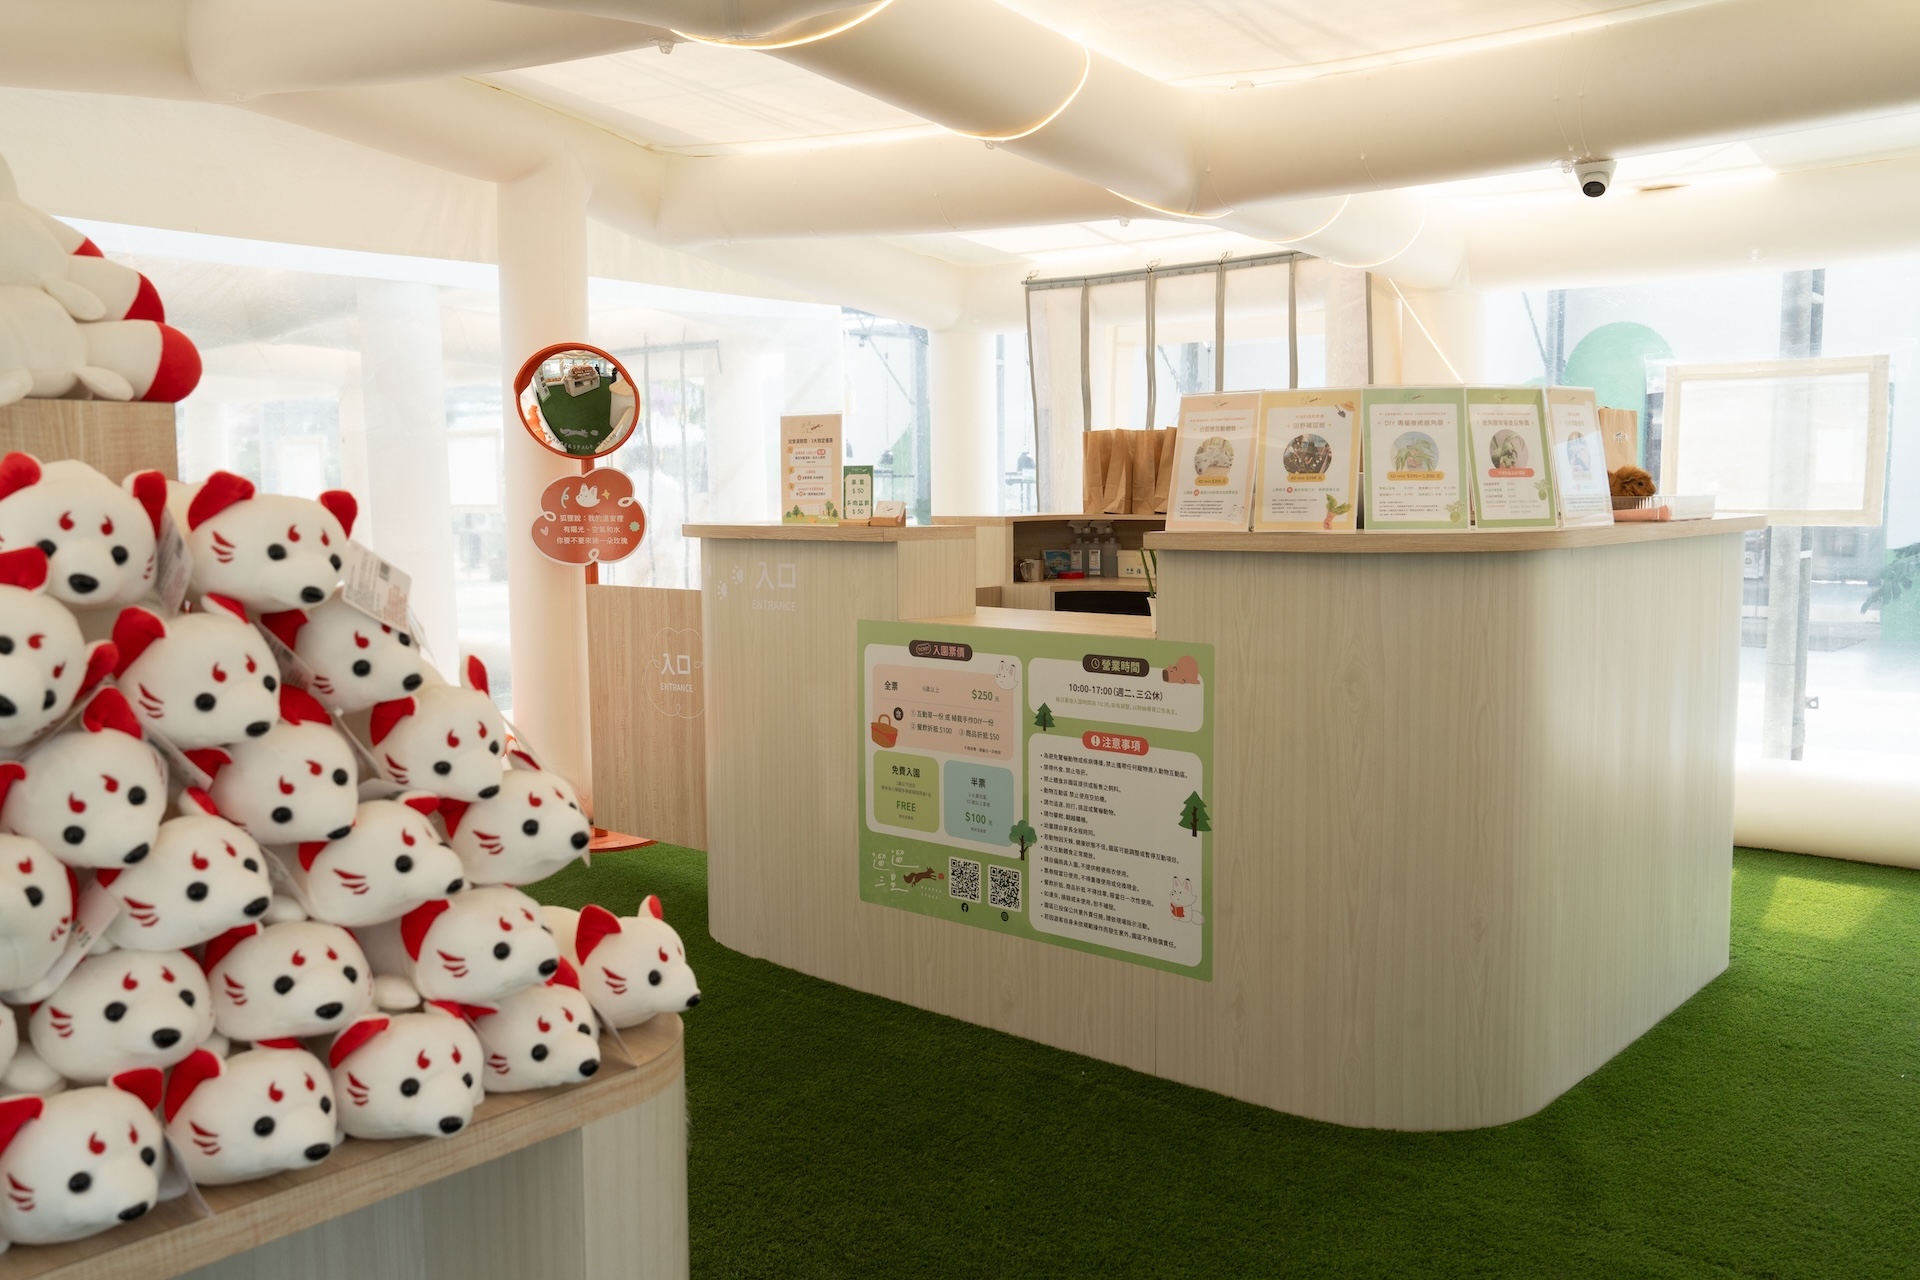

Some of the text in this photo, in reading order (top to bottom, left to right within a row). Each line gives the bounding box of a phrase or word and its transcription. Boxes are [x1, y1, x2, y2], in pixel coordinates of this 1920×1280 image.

[755, 561, 796, 590] 入口
[752, 600, 796, 612] ENTRANCE
[932, 645, 965, 658] 入園票價
[660, 652, 691, 676] 入口
[1101, 659, 1140, 674] 營業時間
[660, 682, 693, 693] ENTRANCE
[884, 680, 899, 692] 全票
[971, 689, 993, 701] $250
[944, 713, 951, 722] 或
[939, 725, 952, 735] $100
[965, 730, 989, 740] 商品折抵
[989, 732, 1000, 741] $50
[1102, 736, 1141, 752] 注意事項
[892, 765, 920, 778] 免費入園
[971, 777, 986, 789] 半票
[896, 801, 916, 812] FREE
[965, 811, 986, 825] $100
